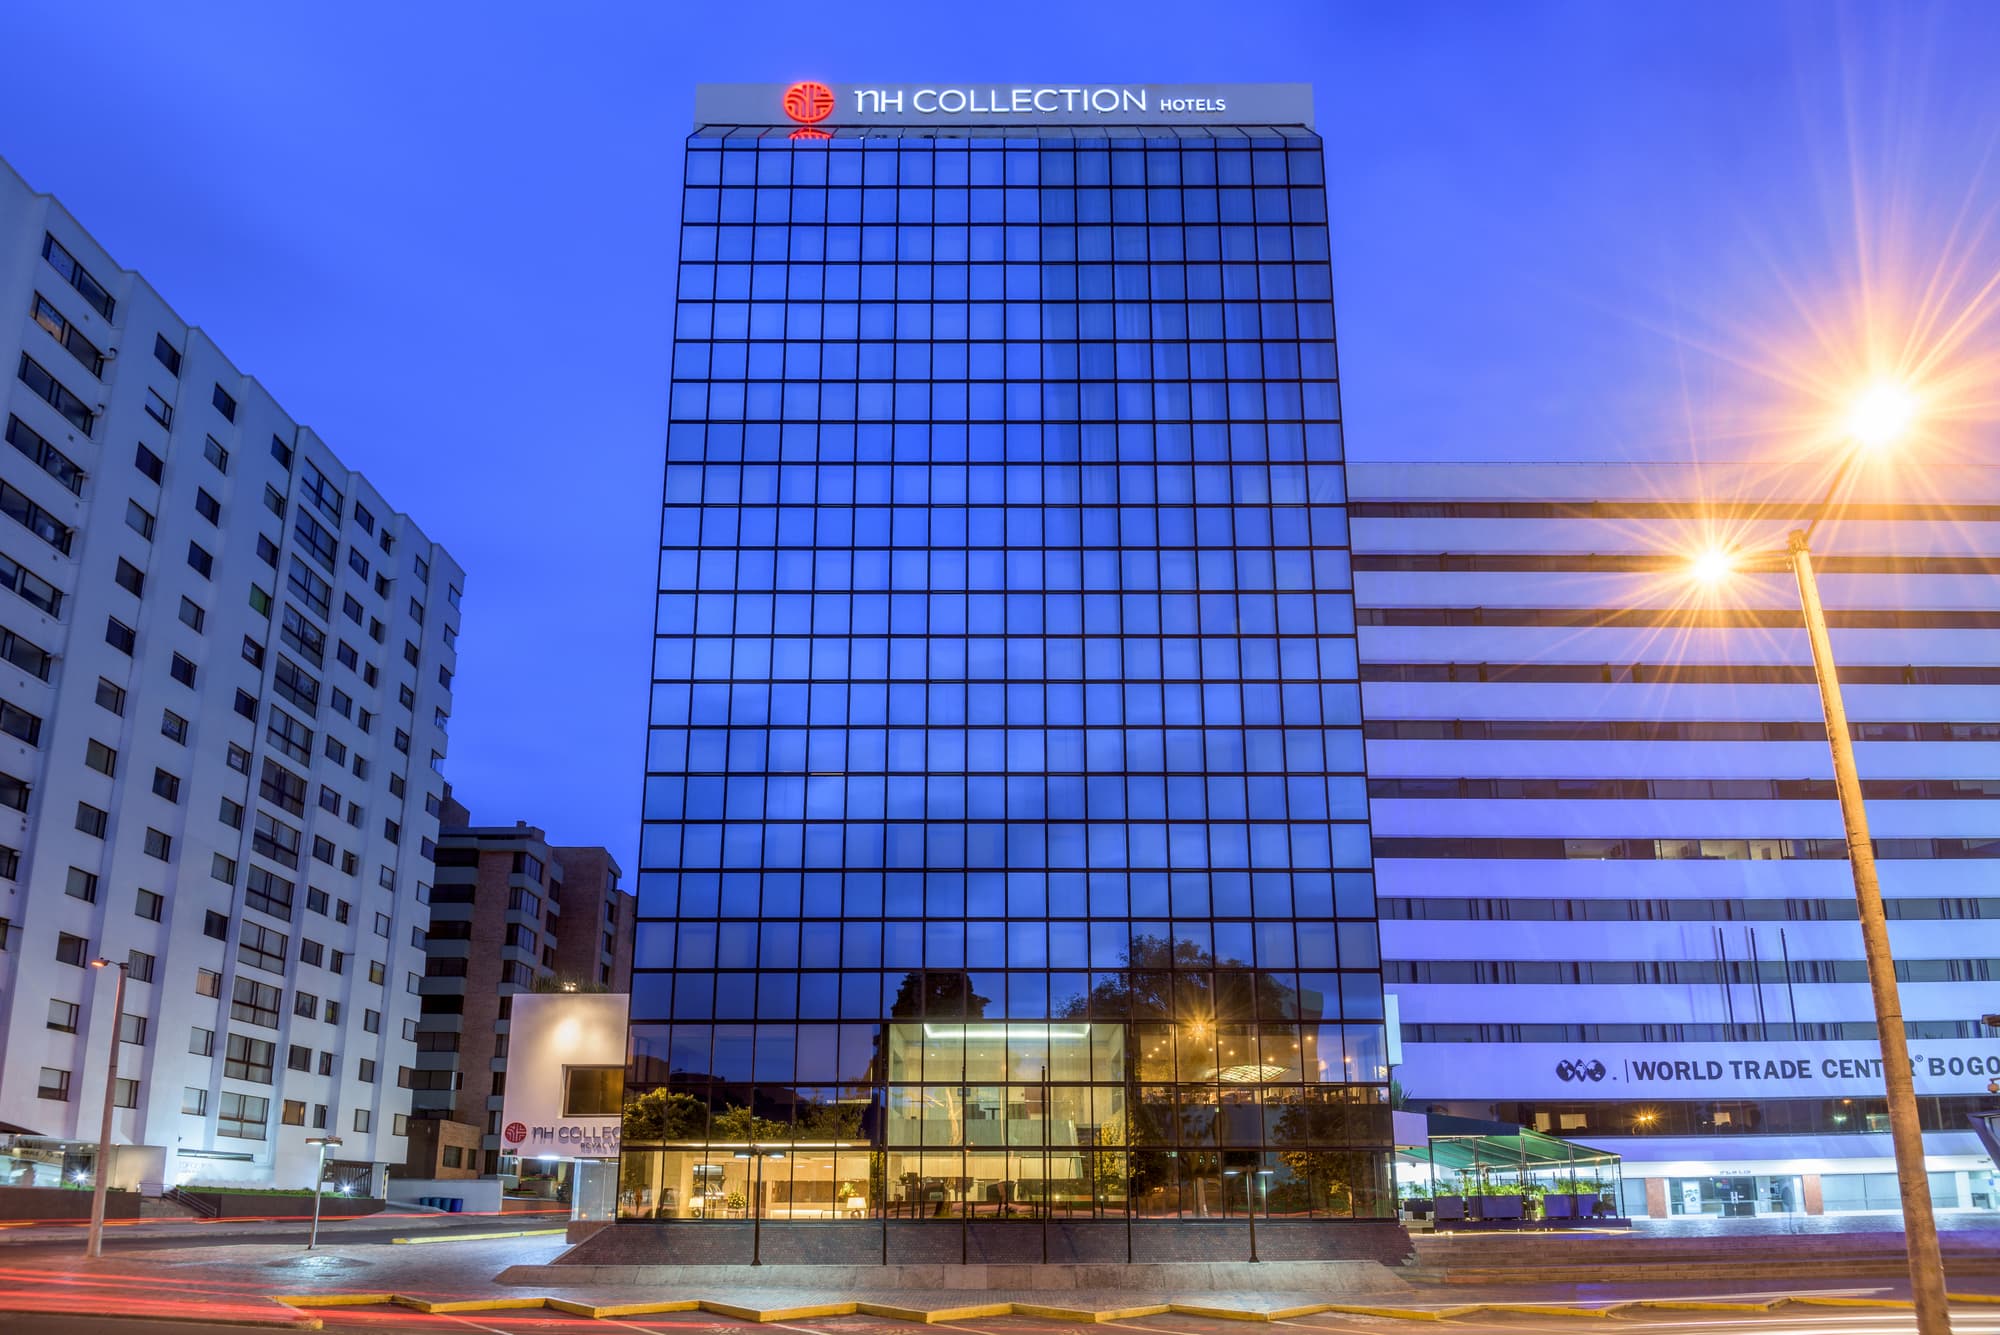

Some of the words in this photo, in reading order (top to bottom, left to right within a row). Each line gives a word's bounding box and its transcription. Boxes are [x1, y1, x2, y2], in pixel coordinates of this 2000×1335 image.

[913, 89, 1146, 112] COLLECTION
[1160, 99, 1226, 111] HOTELS
[1632, 1060, 1724, 1081] WORLD
[1729, 1060, 1813, 1080] TRADE
